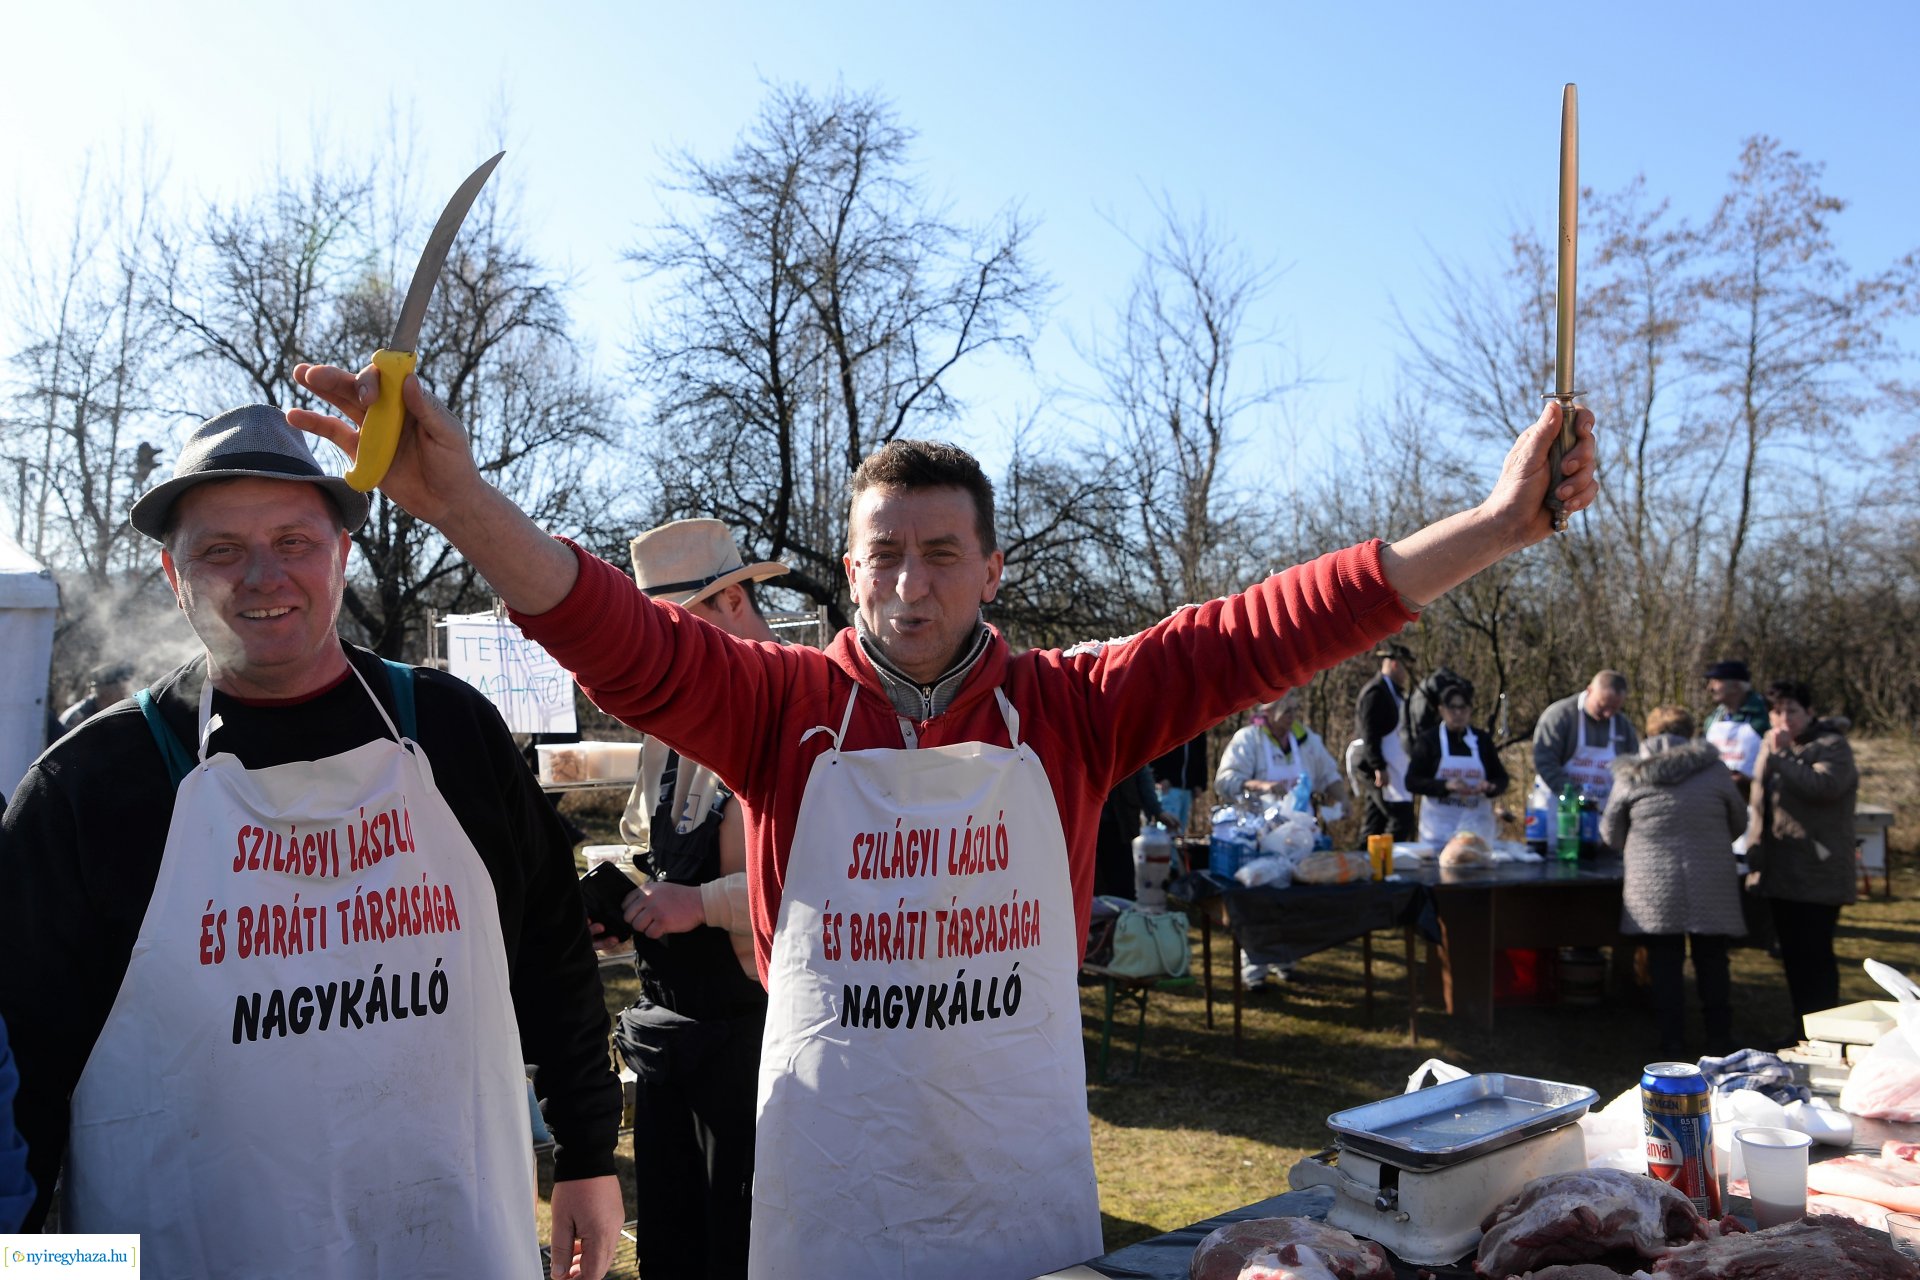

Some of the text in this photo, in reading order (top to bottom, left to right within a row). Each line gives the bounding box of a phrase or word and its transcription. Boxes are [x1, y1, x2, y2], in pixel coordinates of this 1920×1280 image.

[467, 668, 565, 707] APHATÓ!
[233, 795, 416, 878] SZILÁGYI LÁSZLÓ
[848, 810, 1009, 880] SZILÁGYI LÁSZLÓ
[200, 873, 461, 966] ÉS BARÁTI TÁRSASÁGA
[823, 889, 1041, 965] ÉS BARÁTI TÁRSASÁGA
[233, 958, 449, 1045] NAGYKÁLLÓ
[841, 962, 1022, 1031] NAGYKÁLLÓ
